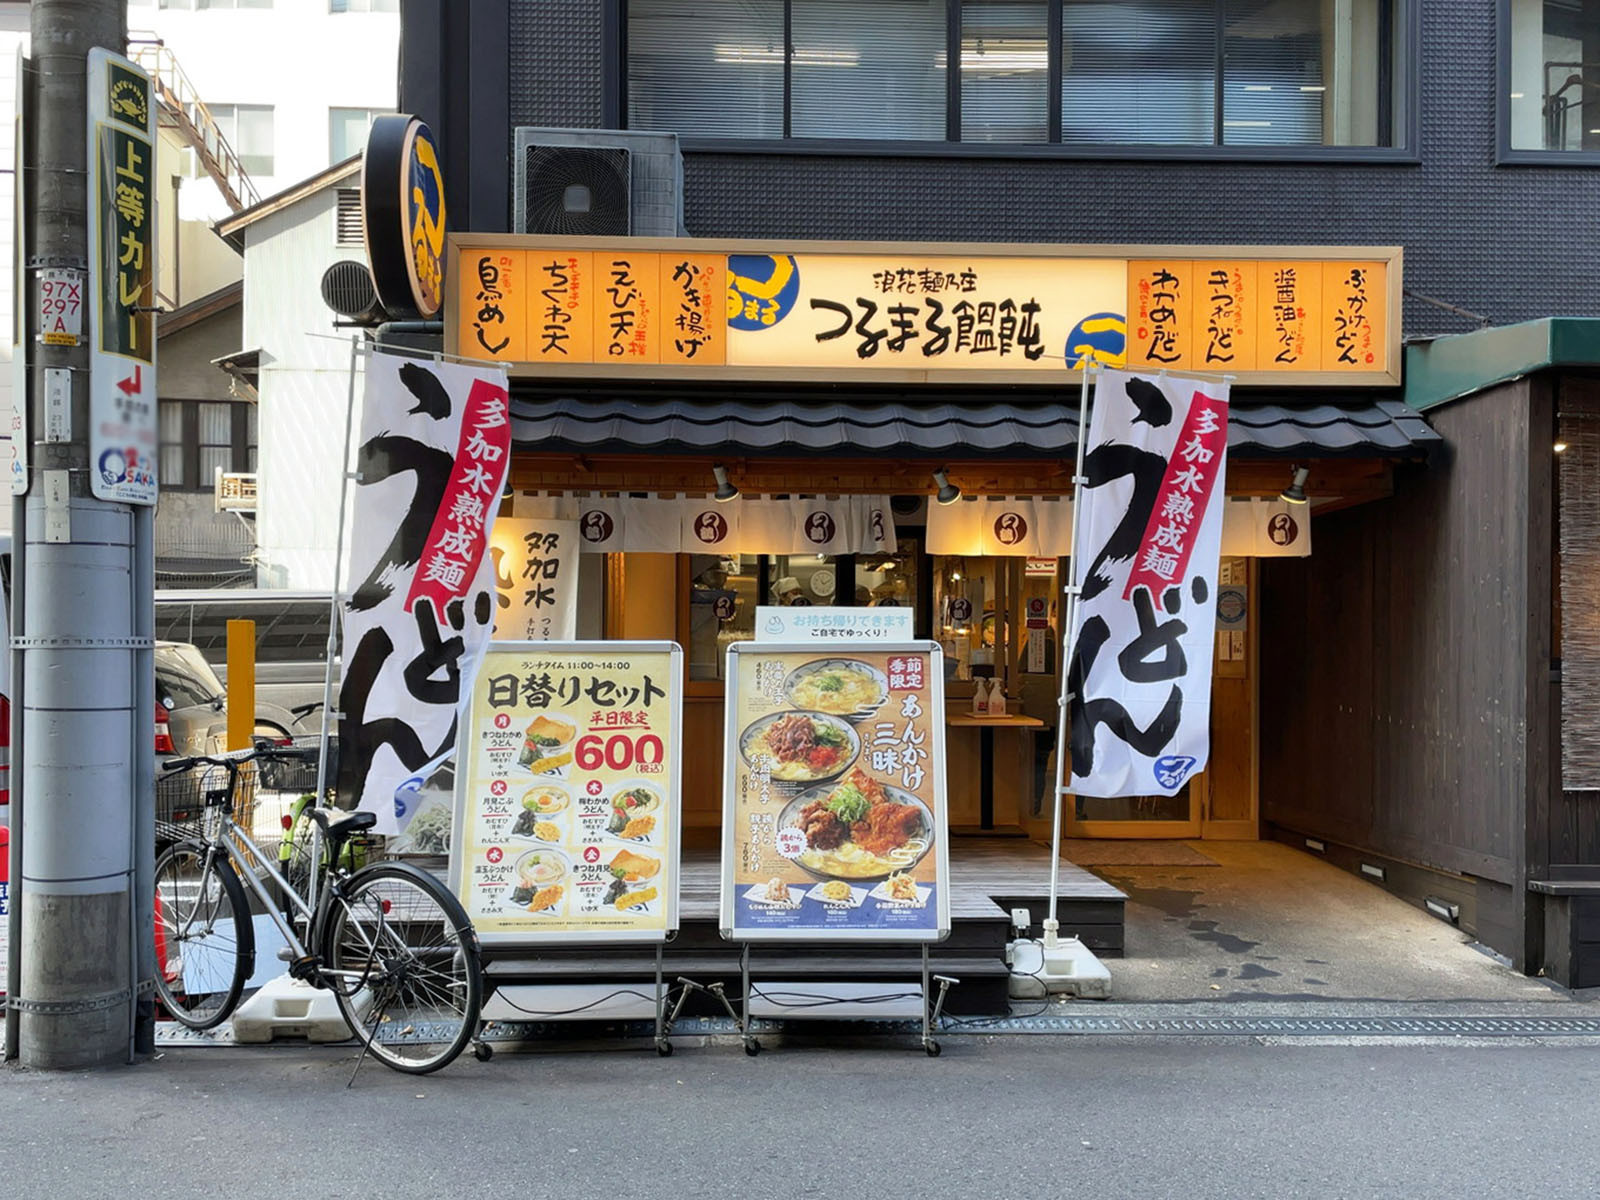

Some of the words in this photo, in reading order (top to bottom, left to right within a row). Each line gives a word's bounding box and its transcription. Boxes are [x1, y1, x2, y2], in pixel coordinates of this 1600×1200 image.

[116, 140, 146, 350] 上等カレー
[43, 281, 80, 299] 97X
[43, 299, 80, 316] 297
[541, 260, 571, 355] ちくわ天
[672, 261, 712, 358] かき揚げ
[1146, 268, 1181, 363] わかめうどん
[1206, 270, 1234, 363] きつねうどん
[1273, 268, 1297, 363] 醤油うどん
[1335, 268, 1367, 364] ぶっかけうどん
[54, 316, 66, 333] A
[810, 297, 1045, 361] つるまる饂飩
[421, 398, 507, 591] 多加水熟成麺
[1138, 407, 1220, 581] 多加水熟成麺
[334, 362, 492, 810] うどん
[1068, 377, 1208, 778] うどん
[793, 615, 909, 627] お持ち帰りできます
[521, 661, 564, 670] ランチタイム
[889, 658, 922, 673] 季節
[488, 673, 665, 709] 日替りセット
[890, 673, 923, 688] 限定
[497, 714, 508, 727] 月
[590, 710, 649, 725] 平日限定
[482, 731, 522, 739] きつねわかめ
[901, 693, 928, 792] あんかけ
[575, 734, 664, 771] 600
[873, 723, 903, 776] 三昧
[483, 797, 514, 805] 月見こぶ
[493, 782, 506, 793] 火
[589, 782, 600, 794] 木
[488, 849, 500, 861] 水
[586, 848, 598, 860] 金
[581, 873, 602, 881] うどん
